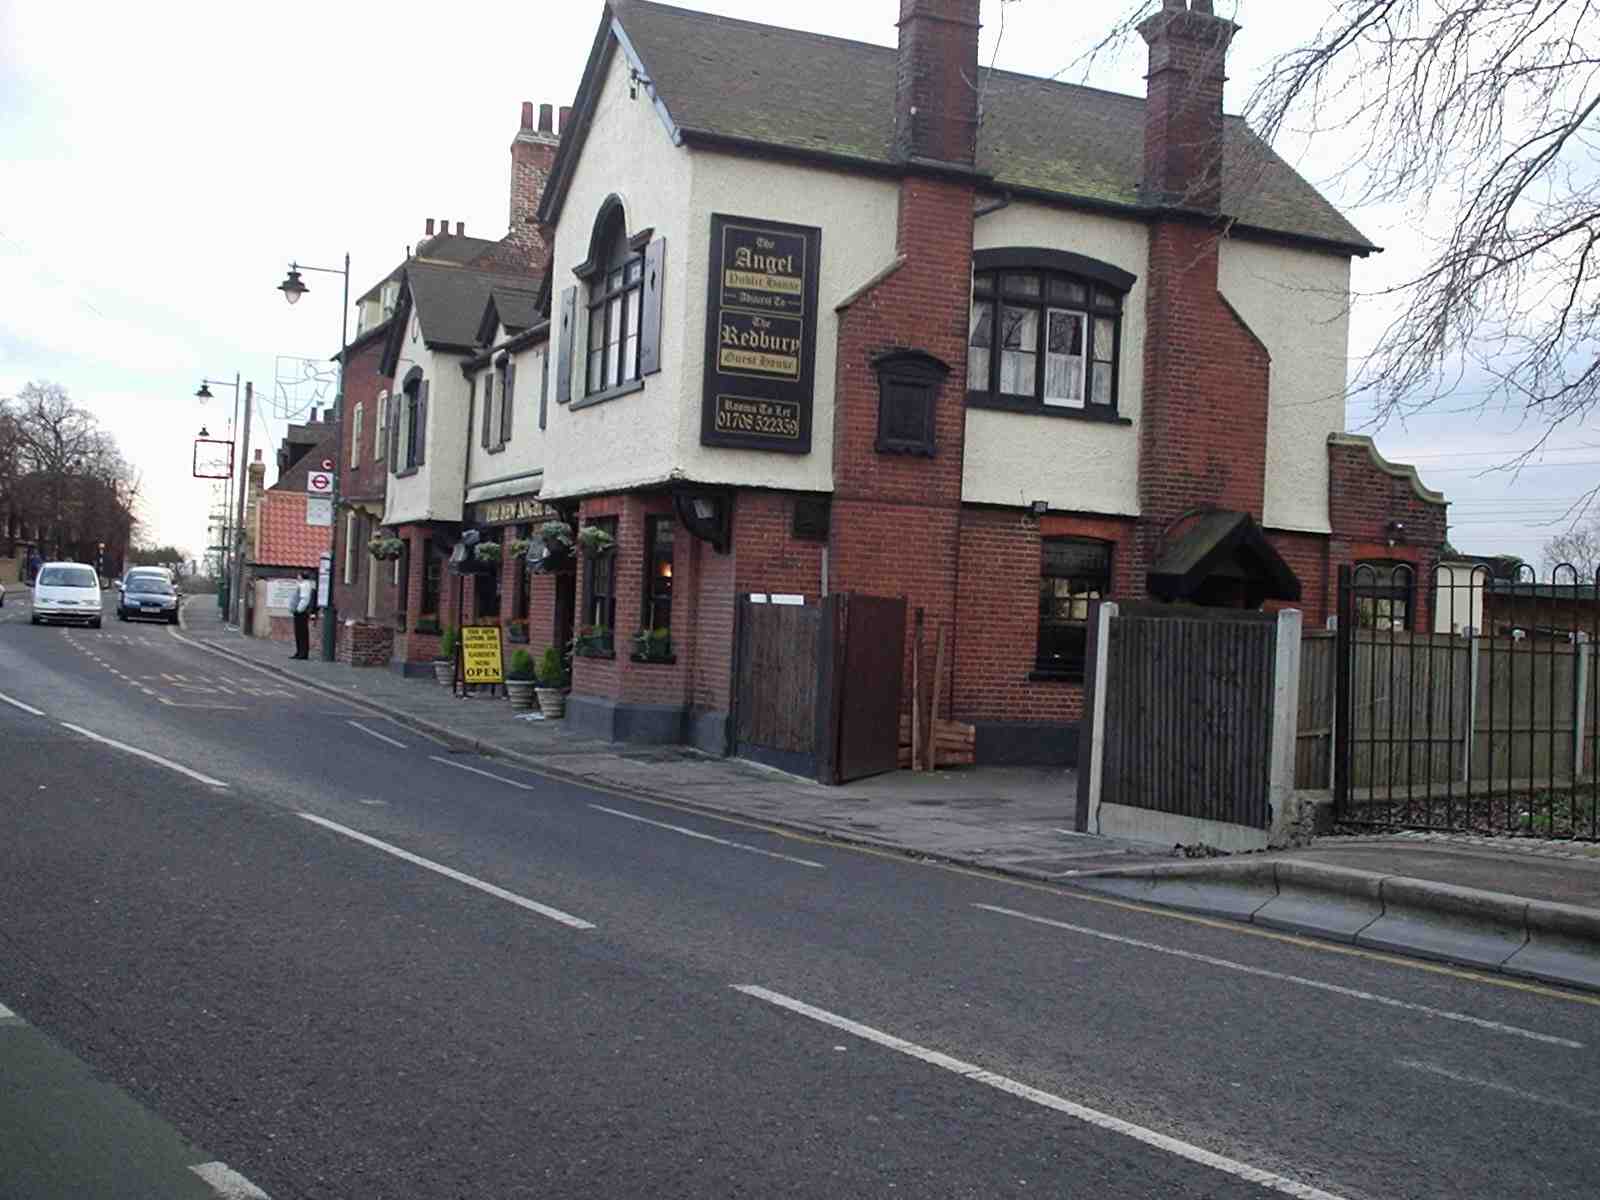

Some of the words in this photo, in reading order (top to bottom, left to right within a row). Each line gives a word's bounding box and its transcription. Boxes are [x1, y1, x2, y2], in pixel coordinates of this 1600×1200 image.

[756, 236, 775, 249] The
[735, 247, 793, 274] Angel
[728, 272, 764, 287] Public
[766, 276, 800, 290] House
[752, 316, 771, 329] The
[720, 324, 801, 356] Redbury
[724, 352, 757, 366] Guest
[759, 355, 793, 370] House
[724, 399, 757, 413] Rooms
[759, 403, 772, 415] To
[775, 405, 792, 417] Let
[718, 410, 753, 430] 01708
[466, 667, 500, 677] OPEN
